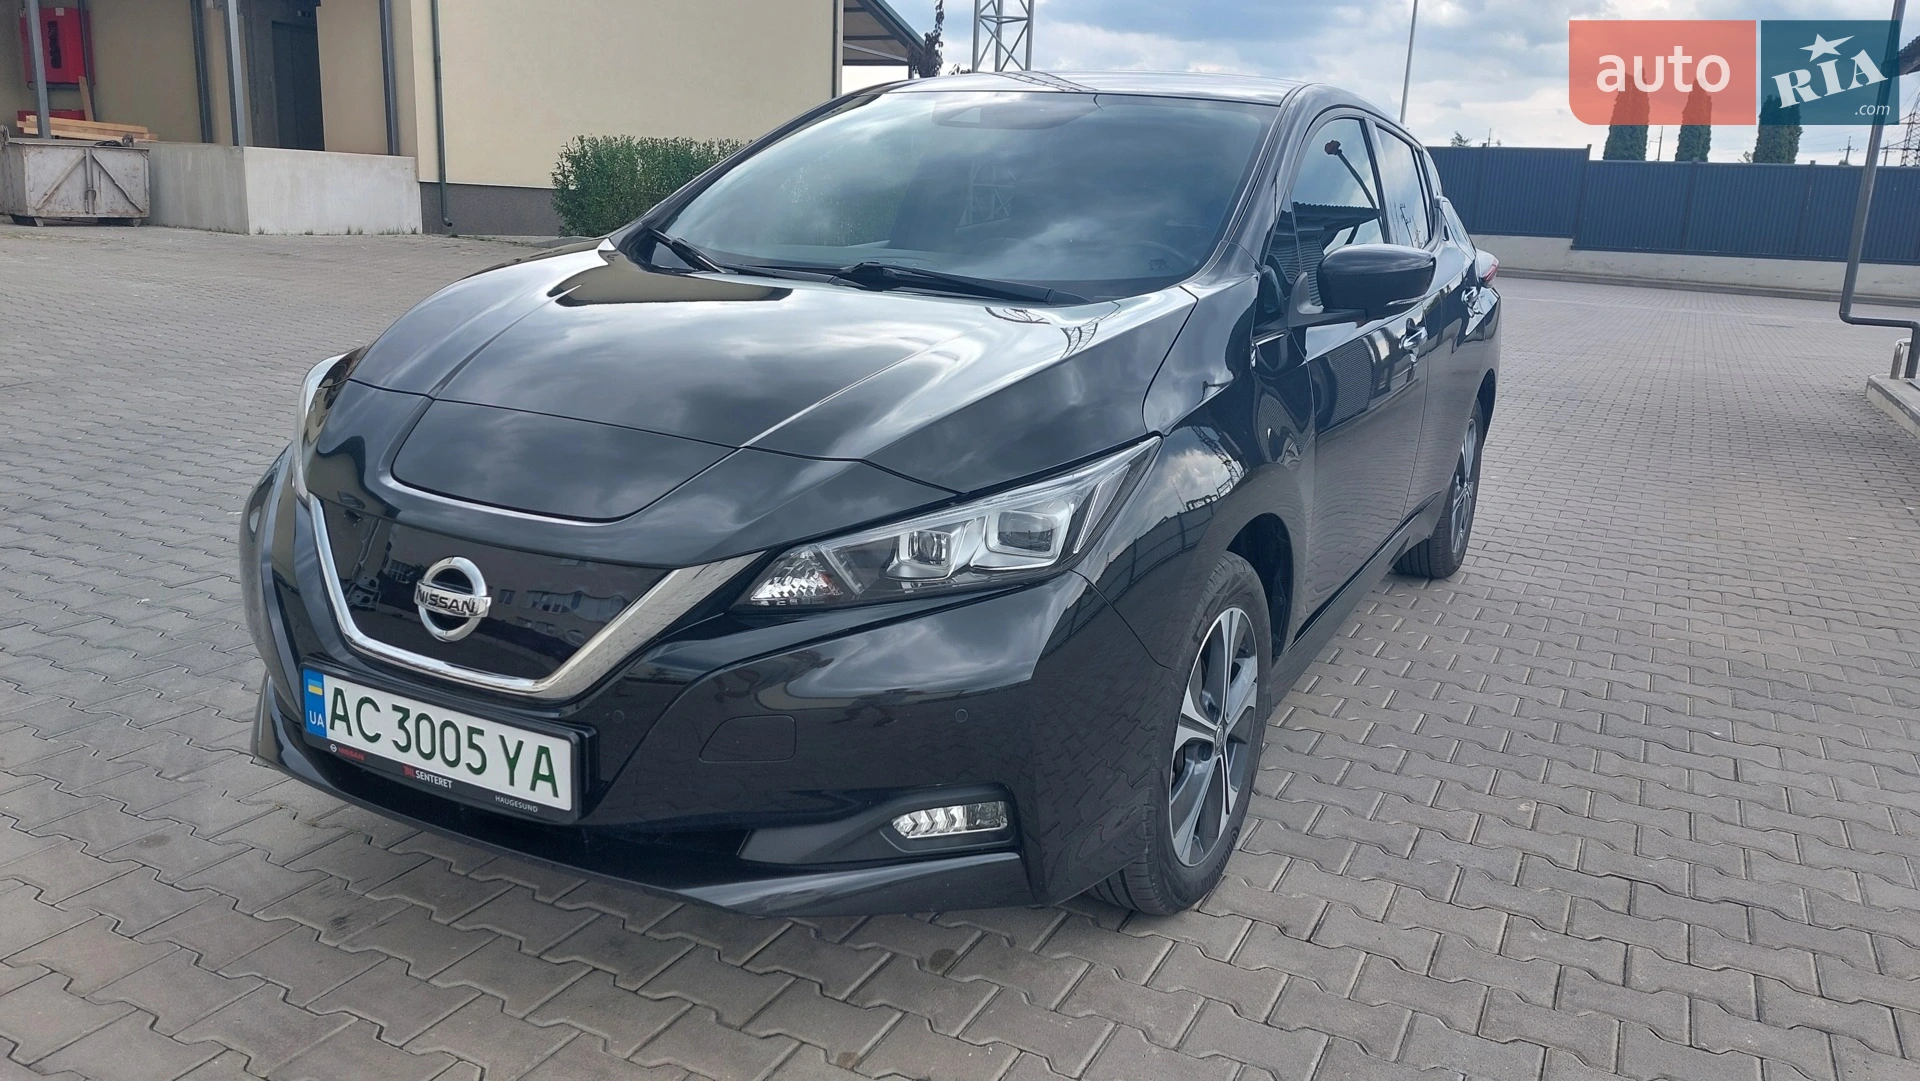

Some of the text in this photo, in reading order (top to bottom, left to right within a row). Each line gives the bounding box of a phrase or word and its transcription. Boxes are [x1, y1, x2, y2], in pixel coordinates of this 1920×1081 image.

[416, 586, 476, 613] NISSAN
[309, 710, 325, 728] UA
[329, 686, 560, 799] AC 3005 YA
[495, 795, 538, 813] HAUGESUND
